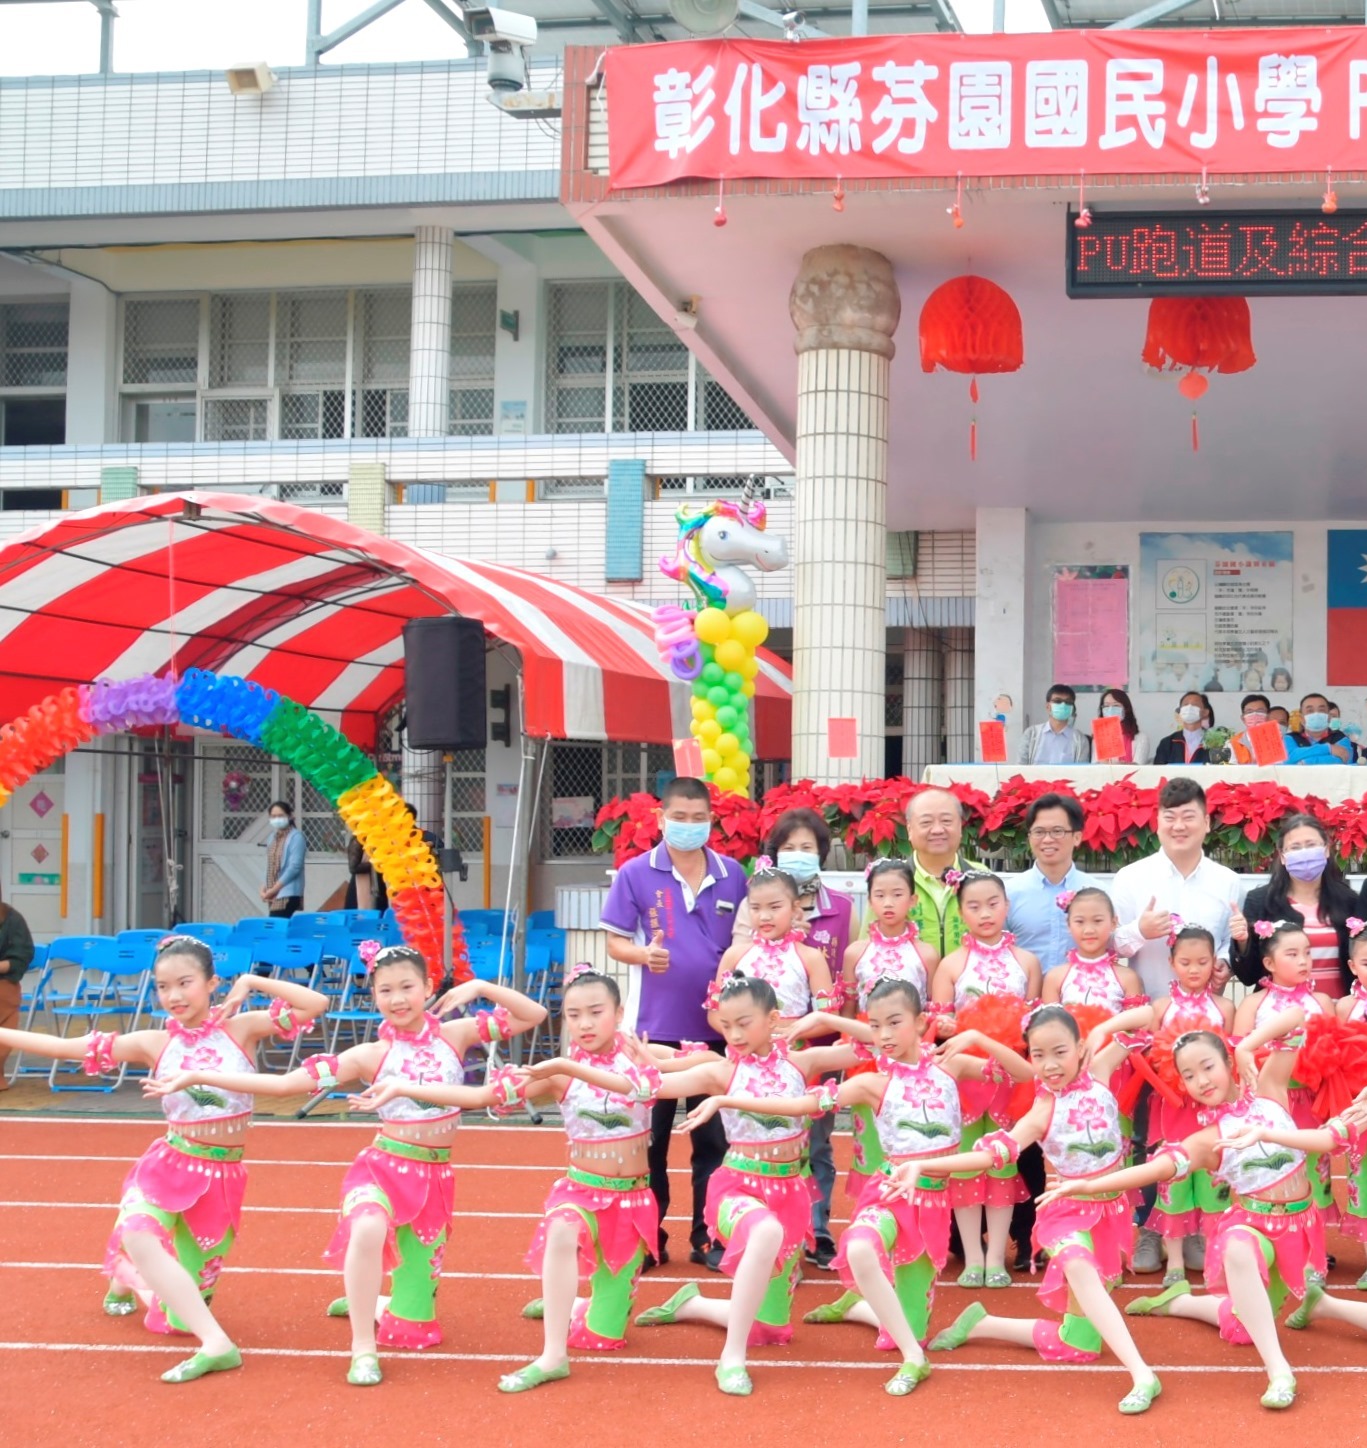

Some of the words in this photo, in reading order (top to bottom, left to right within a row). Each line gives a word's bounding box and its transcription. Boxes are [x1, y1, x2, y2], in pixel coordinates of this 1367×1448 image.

[653, 53, 1322, 160] 彰化縣芬園國民小學
